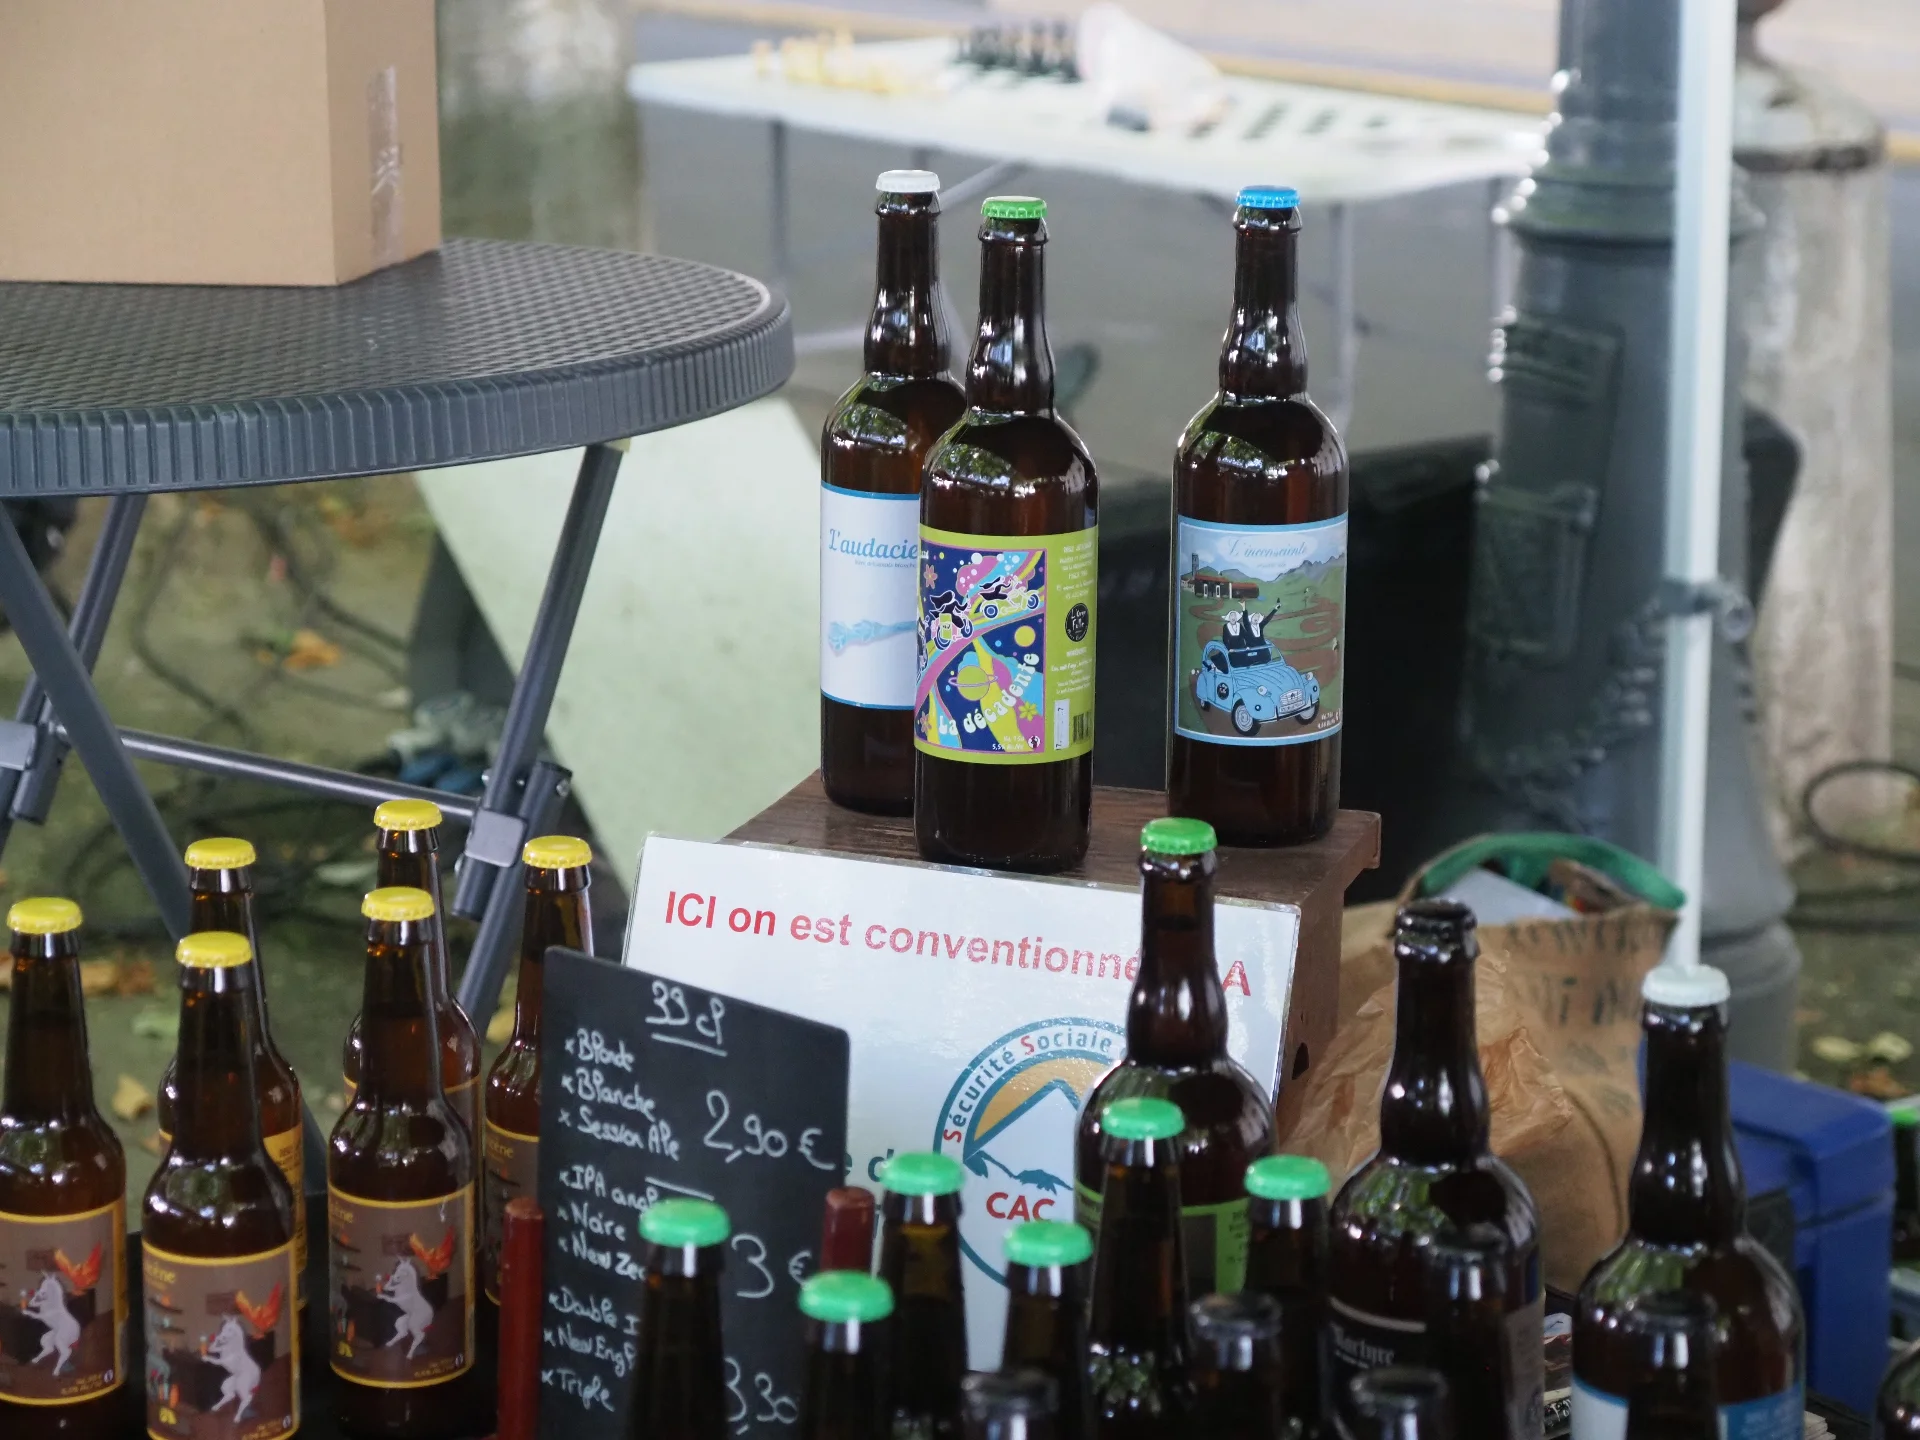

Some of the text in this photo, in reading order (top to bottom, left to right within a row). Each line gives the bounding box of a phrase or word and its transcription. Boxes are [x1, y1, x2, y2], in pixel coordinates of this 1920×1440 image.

[829, 528, 918, 559] L'audacie
[939, 715, 958, 736] La
[963, 653, 1040, 733] décadente
[665, 890, 717, 929] ICI
[728, 906, 776, 936] on
[790, 914, 852, 946] est
[576, 1028, 635, 1072] Blonde
[575, 1066, 656, 1122] Blanche
[943, 1028, 1112, 1143] Sécurité Sociale
[577, 1104, 645, 1149] Session
[703, 1090, 788, 1163] 2,90
[798, 1127, 836, 1170] €
[570, 1164, 659, 1214] IPA angl
[986, 1191, 1056, 1222] CAC
[570, 1200, 627, 1242] Noire
[571, 1230, 612, 1270] New
[731, 1233, 775, 1299] 3
[553, 1285, 618, 1329] Double
[557, 1322, 637, 1378] New Engl
[556, 1367, 616, 1412] Triple
[725, 1356, 799, 1436] 3,30
